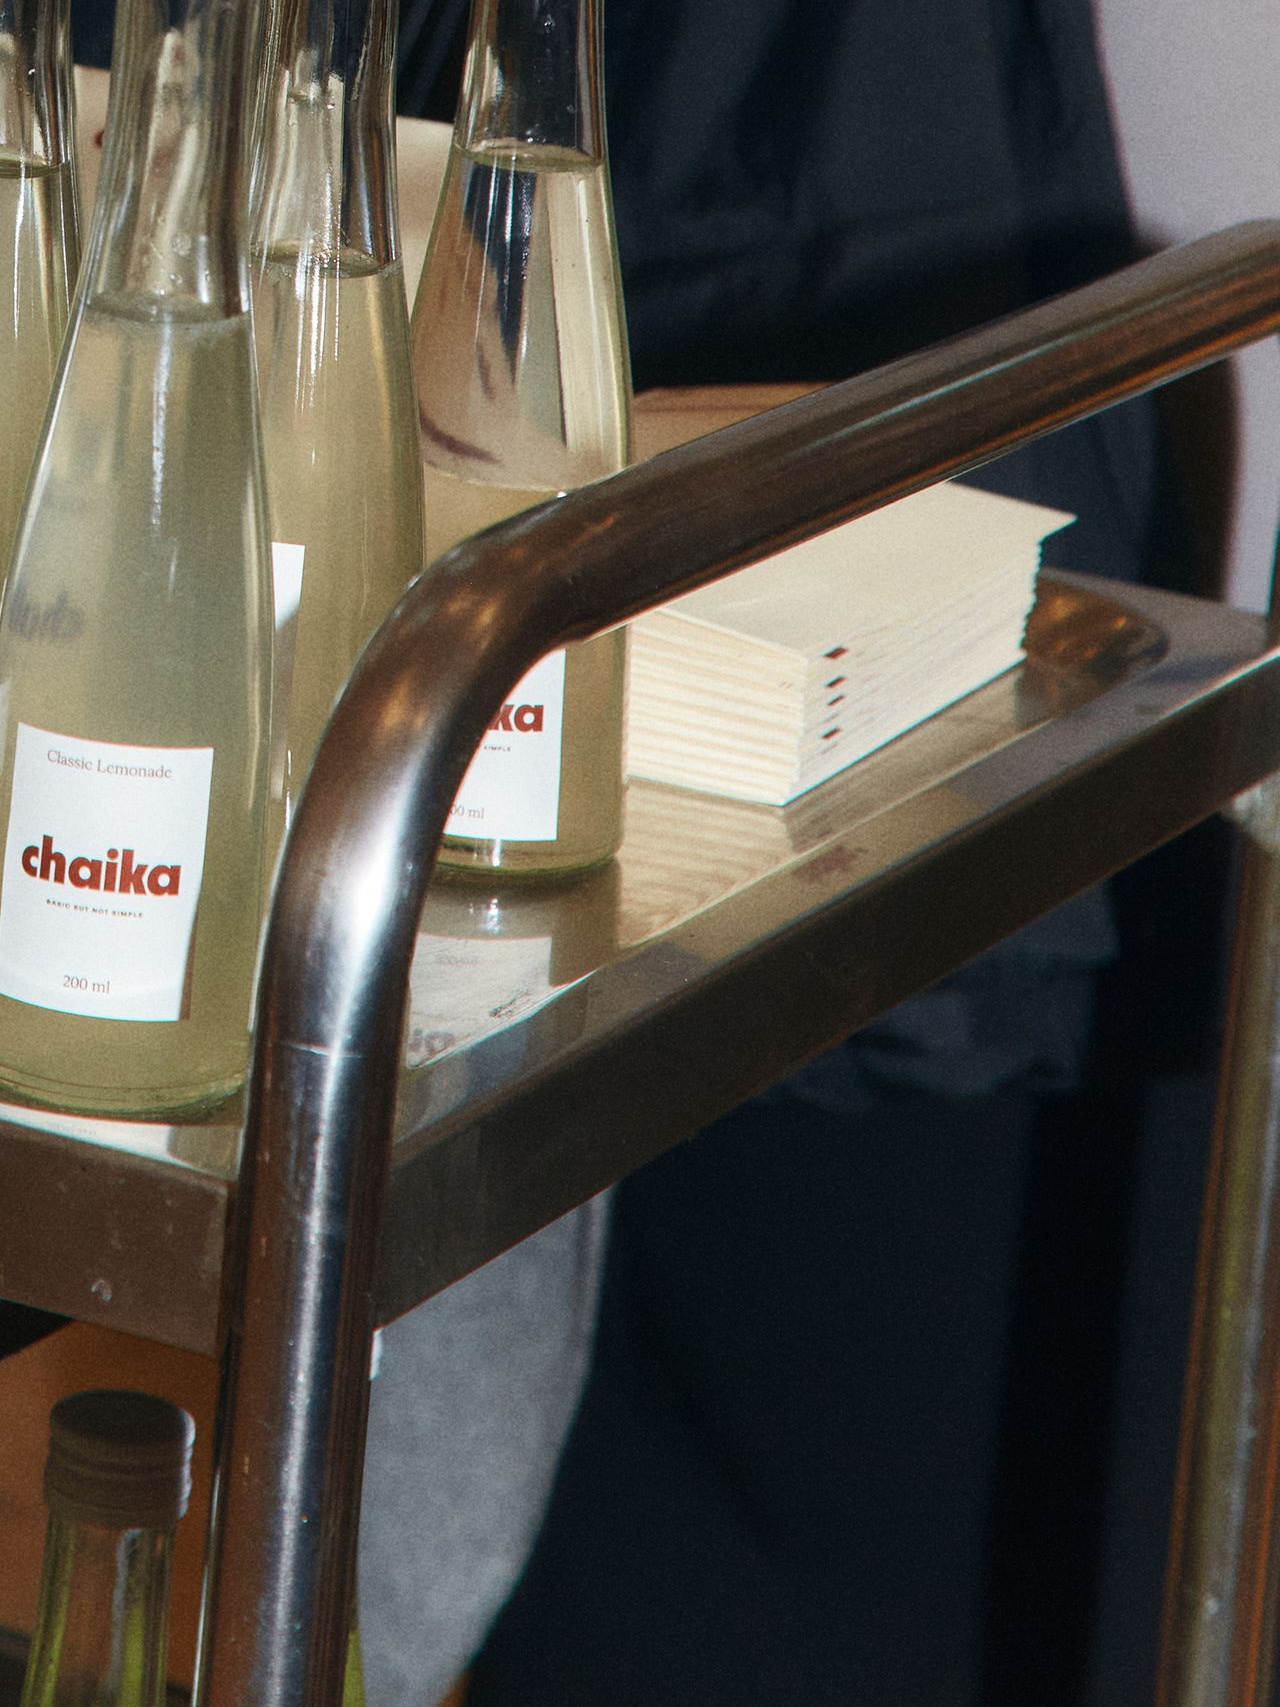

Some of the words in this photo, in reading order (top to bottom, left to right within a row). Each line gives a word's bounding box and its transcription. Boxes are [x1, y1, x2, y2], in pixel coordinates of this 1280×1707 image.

[47, 749, 92, 771] Classic
[97, 760, 172, 779] Lemonade
[449, 804, 465, 816] 00
[469, 807, 485, 820] ml
[22, 834, 182, 897] chaika
[46, 898, 70, 909] BASIC
[73, 905, 89, 913] BUT
[112, 910, 143, 919] SIMPLE
[62, 975, 88, 991] 200
[92, 981, 110, 994] ml
